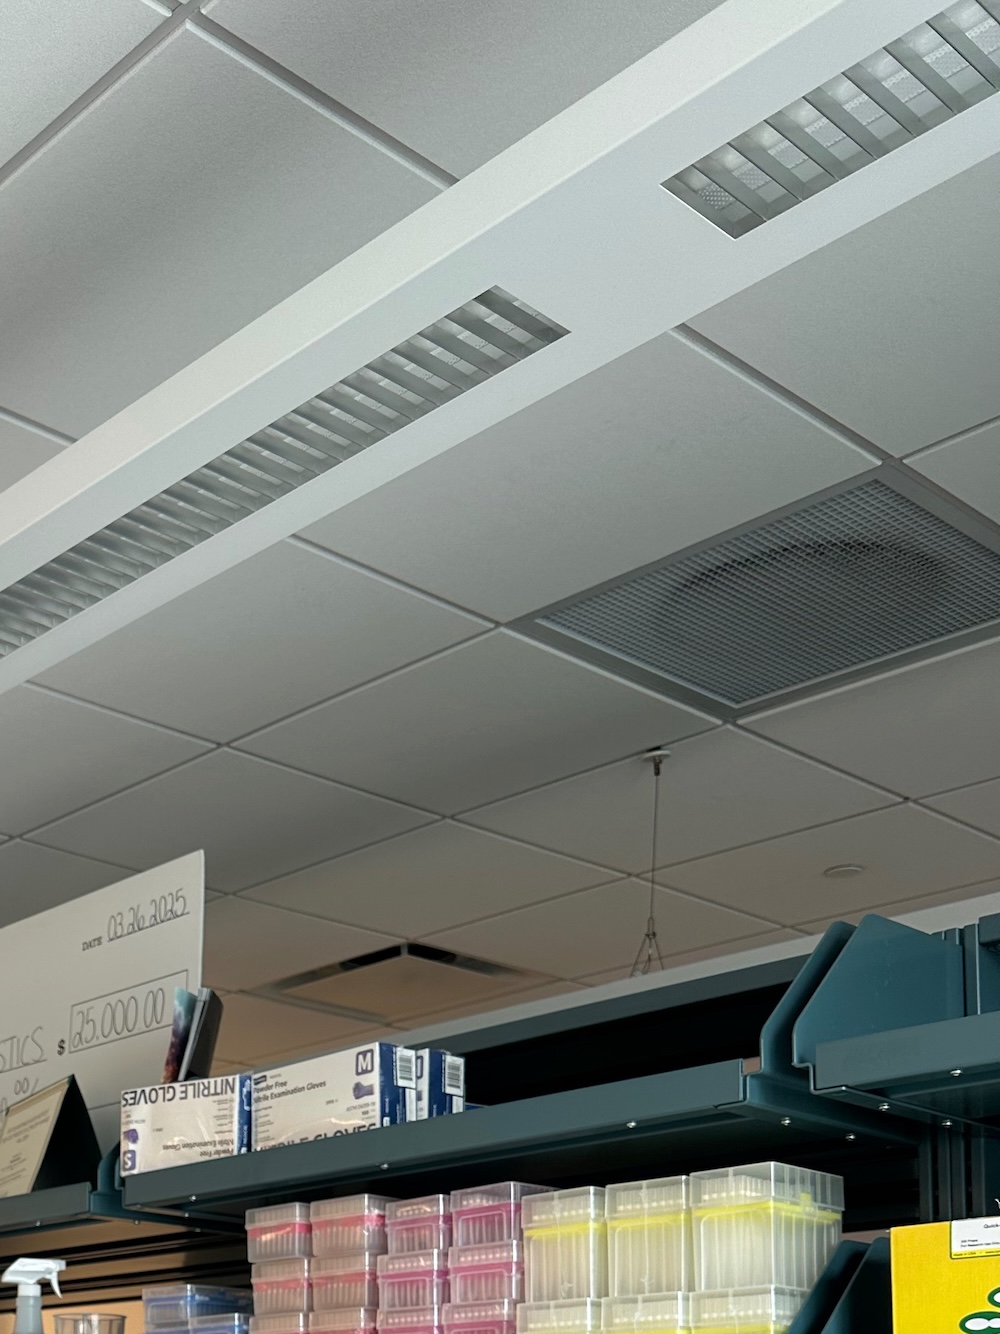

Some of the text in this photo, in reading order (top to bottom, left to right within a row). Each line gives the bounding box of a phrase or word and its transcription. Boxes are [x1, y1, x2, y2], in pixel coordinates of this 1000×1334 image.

[357, 1050, 372, 1073] M
[121, 1077, 236, 1108] NITRILE GLOVES
[270, 1086, 306, 1101] Examination
[306, 1081, 327, 1091] Gloves
[274, 1080, 288, 1089] Free
[123, 1153, 132, 1169] S
